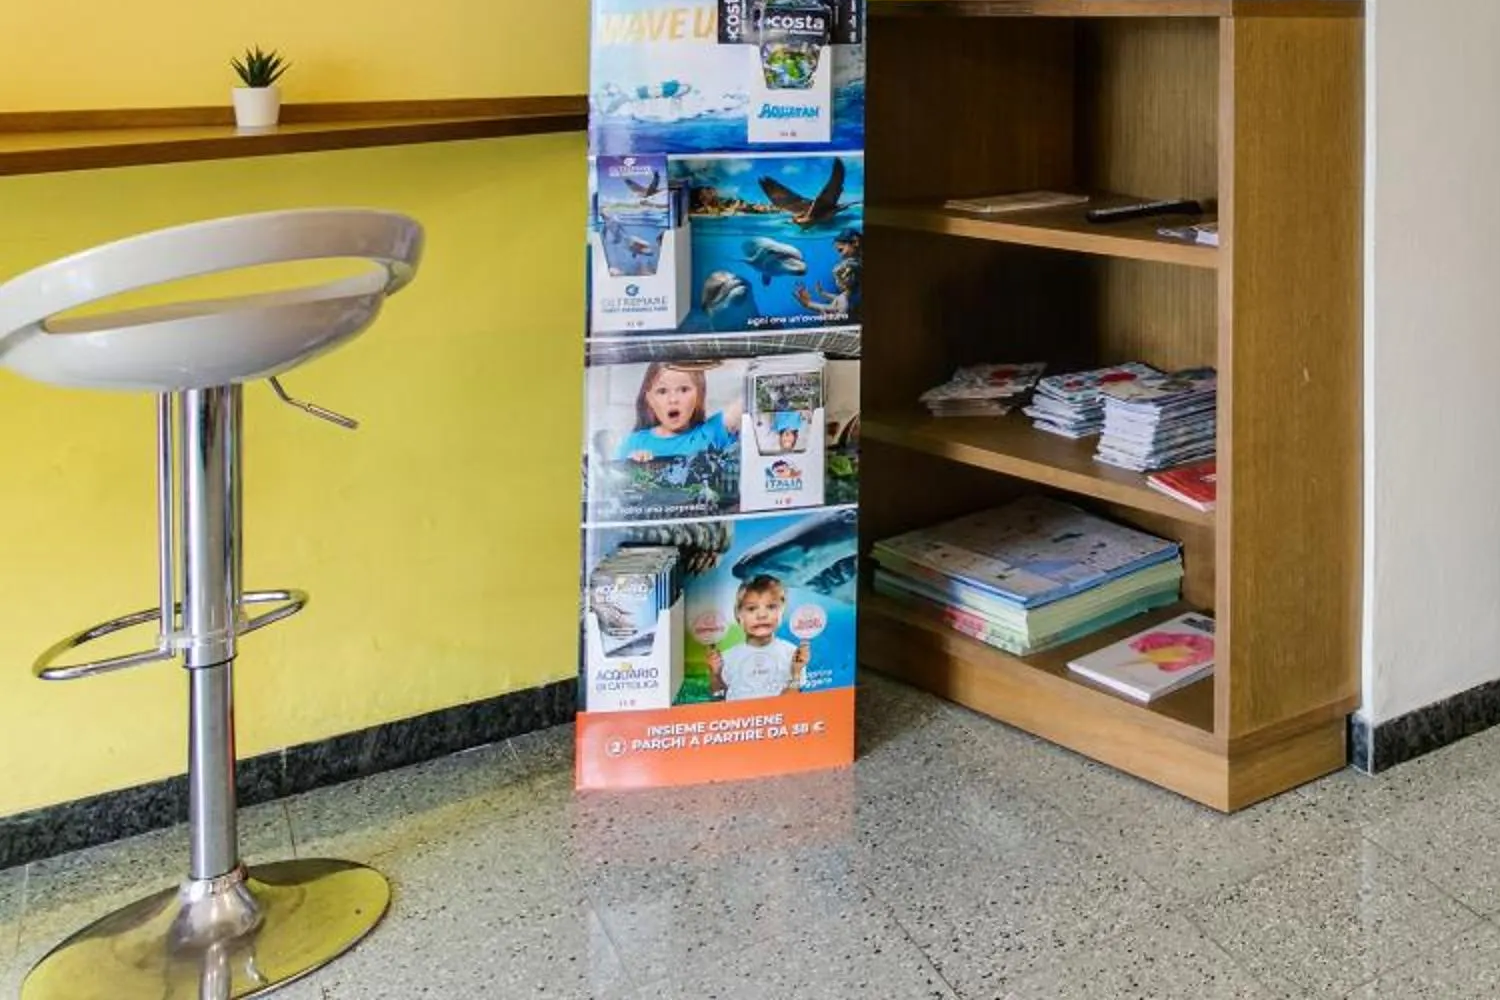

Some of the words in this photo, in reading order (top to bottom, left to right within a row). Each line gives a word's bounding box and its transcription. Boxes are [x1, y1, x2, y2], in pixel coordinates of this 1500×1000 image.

[770, 15, 825, 30] costa
[595, 667, 659, 680] ACQUARIO
[647, 721, 705, 737] INSIEME
[709, 713, 783, 731] CONVIENE
[631, 735, 686, 750] PARCHI
[690, 735, 700, 746] A
[703, 728, 765, 745] PARTIRE
[767, 725, 789, 738] DA
